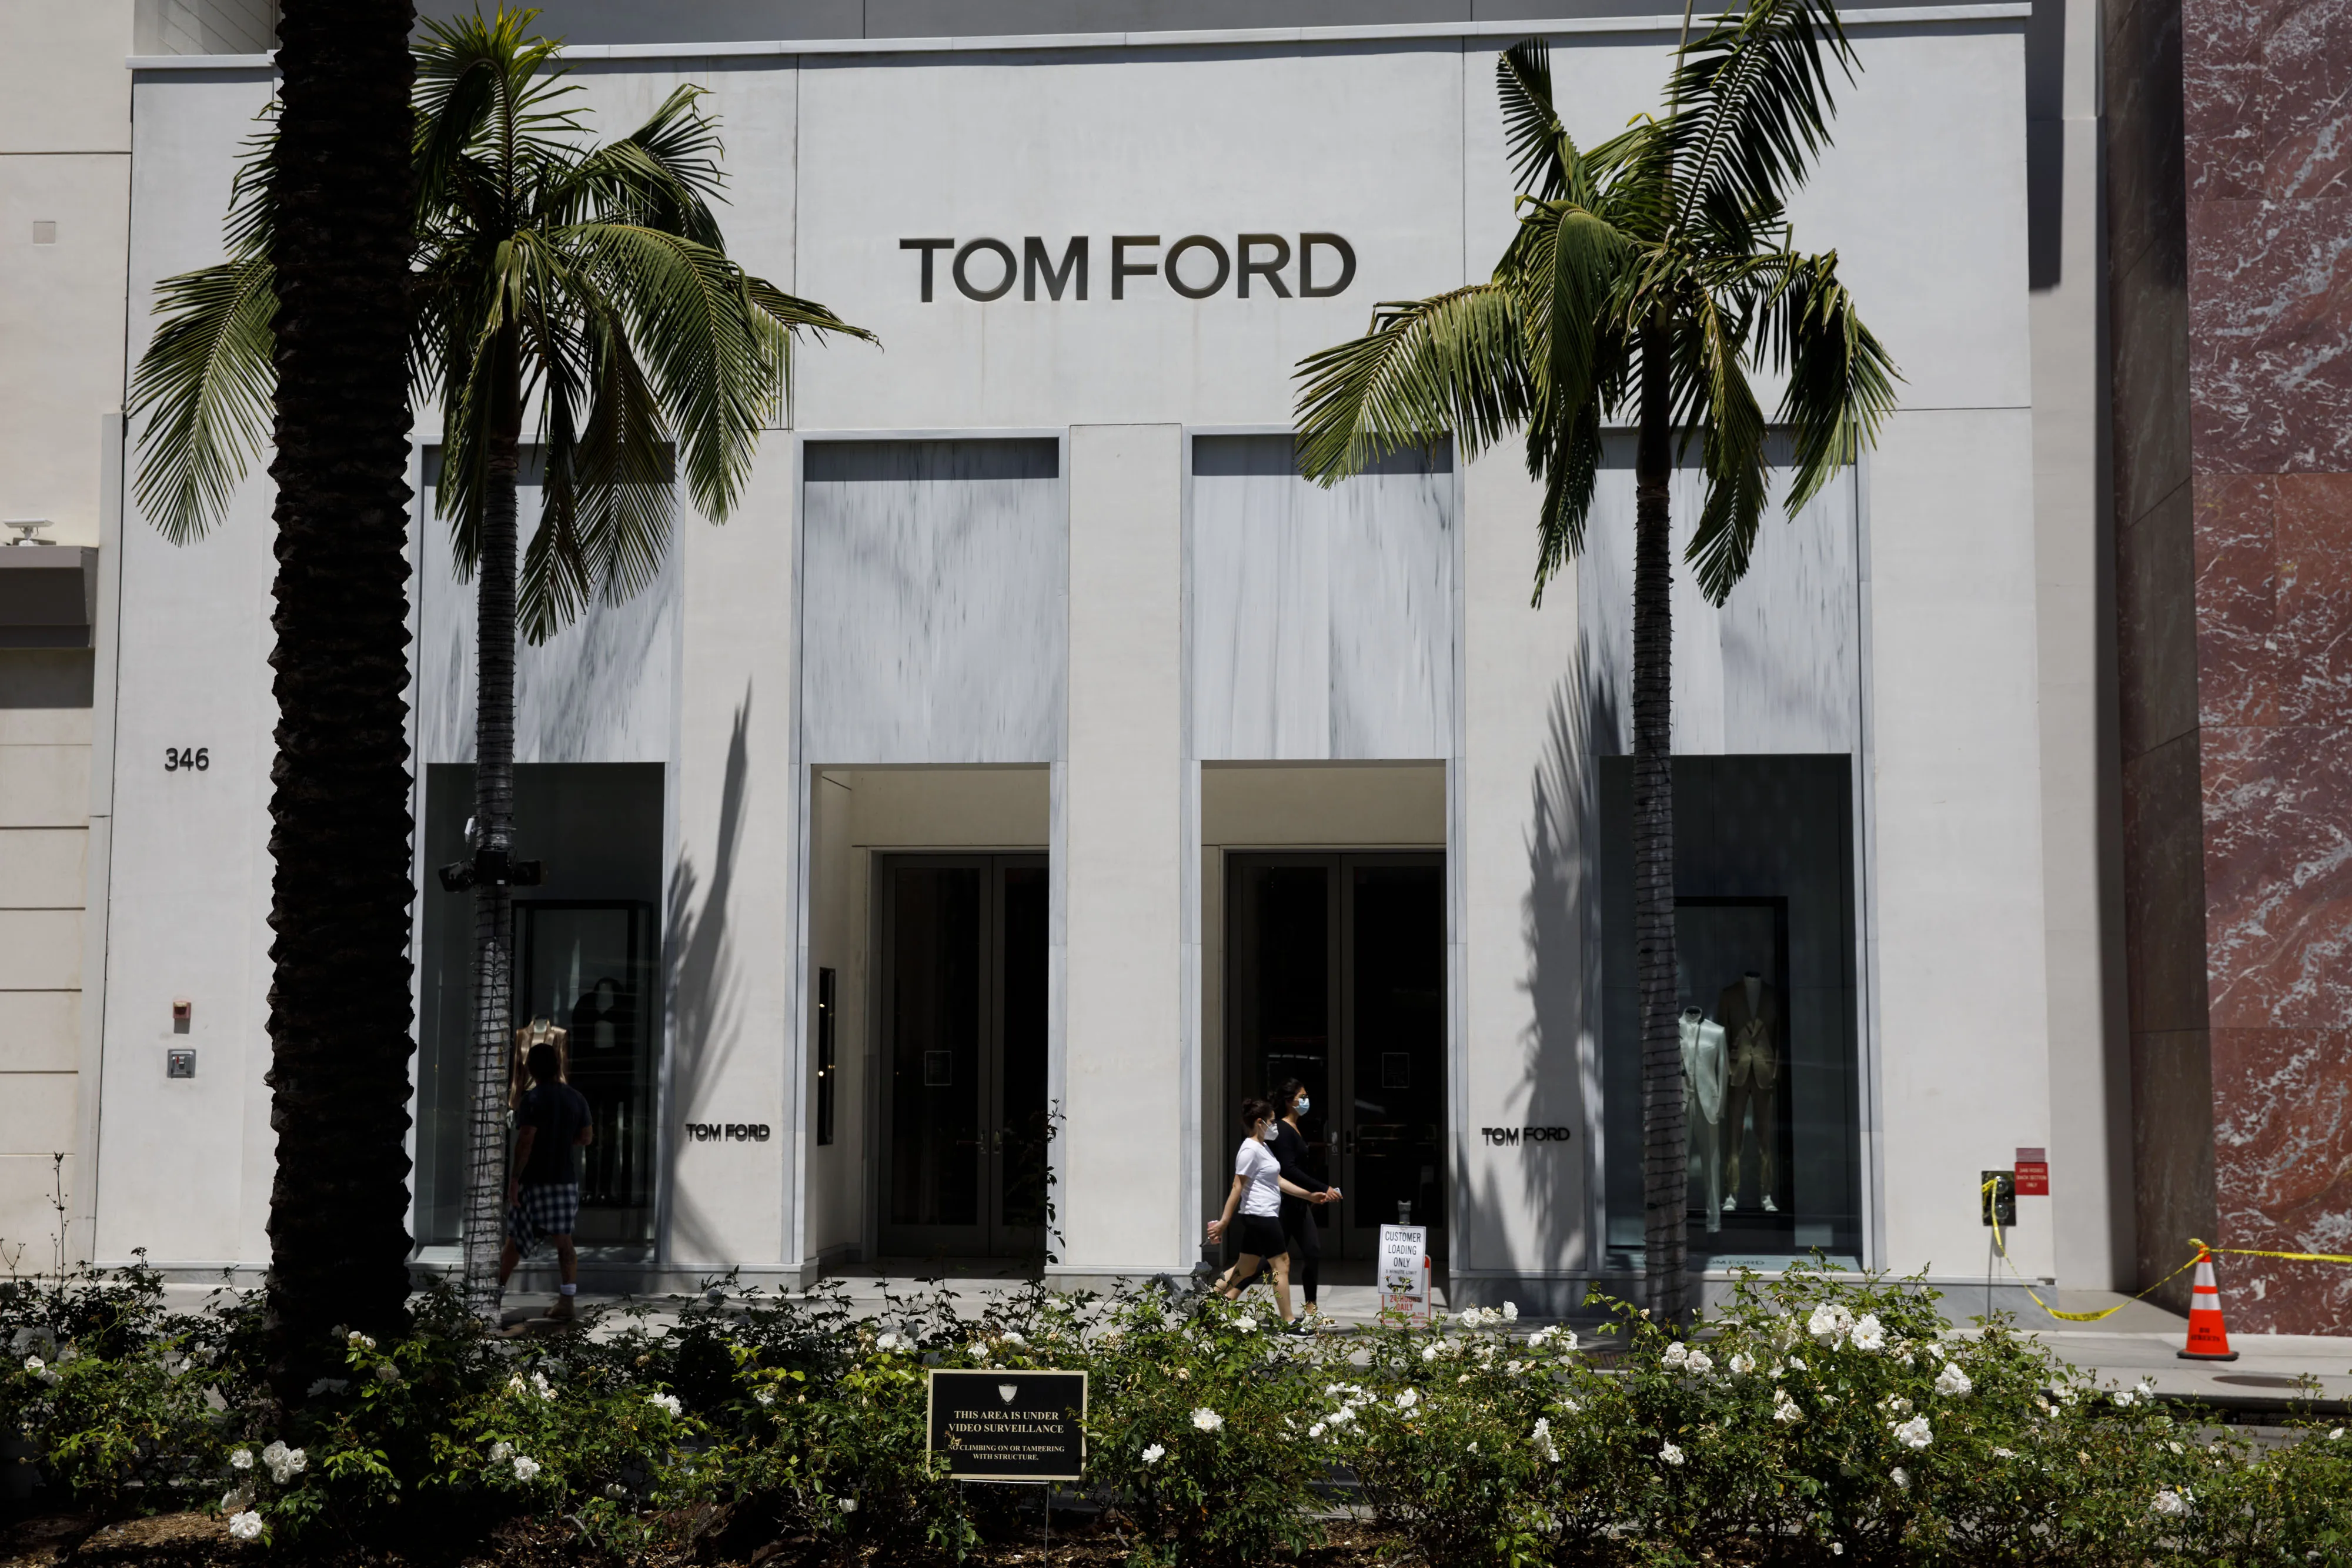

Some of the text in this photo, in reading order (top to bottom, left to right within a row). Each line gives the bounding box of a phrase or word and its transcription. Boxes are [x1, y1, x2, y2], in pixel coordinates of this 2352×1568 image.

[900, 232, 1357, 303] TOM FORD
[165, 747, 209, 772] 346
[686, 1124, 770, 1141] TOM FORD
[1481, 1127, 1571, 1145] TOM FORD
[1385, 1231, 1421, 1243] CUSTOMER
[1388, 1244, 1416, 1255] LOADING
[1394, 1257, 1411, 1268] ONLY
[1396, 1303, 1414, 1311] DAILY
[954, 1410, 1059, 1420] THIS AREA IS UNDER
[948, 1423, 1064, 1433] VIDEO SURVEILLANCE
